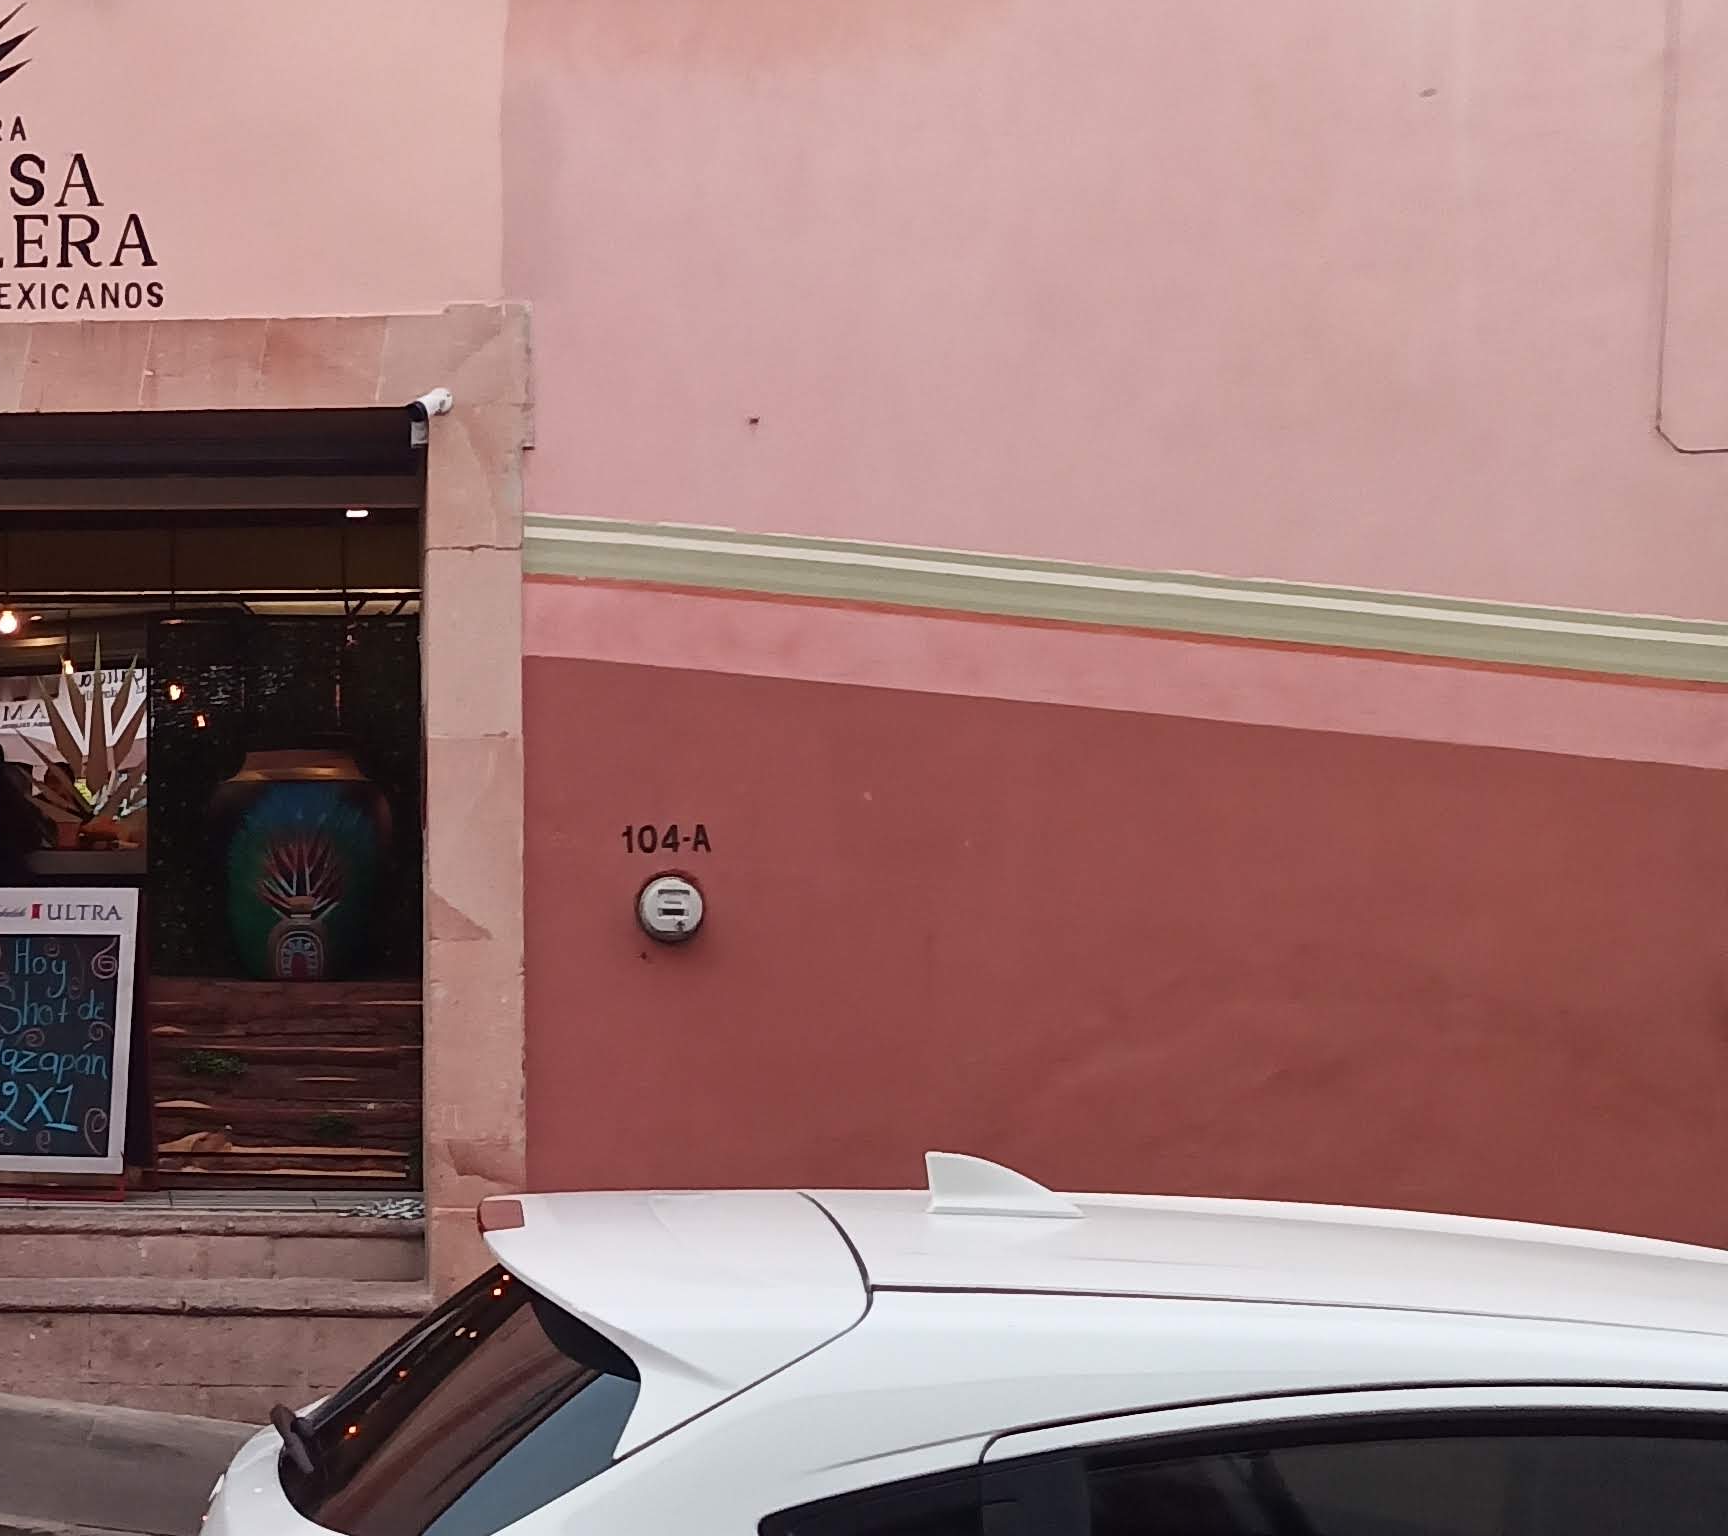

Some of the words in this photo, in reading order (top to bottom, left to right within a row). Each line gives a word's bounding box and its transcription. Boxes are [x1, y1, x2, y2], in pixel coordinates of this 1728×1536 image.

[621, 824, 712, 854] 104-A
[47, 903, 124, 921] ULTRA
[14, 938, 67, 998] Hoy
